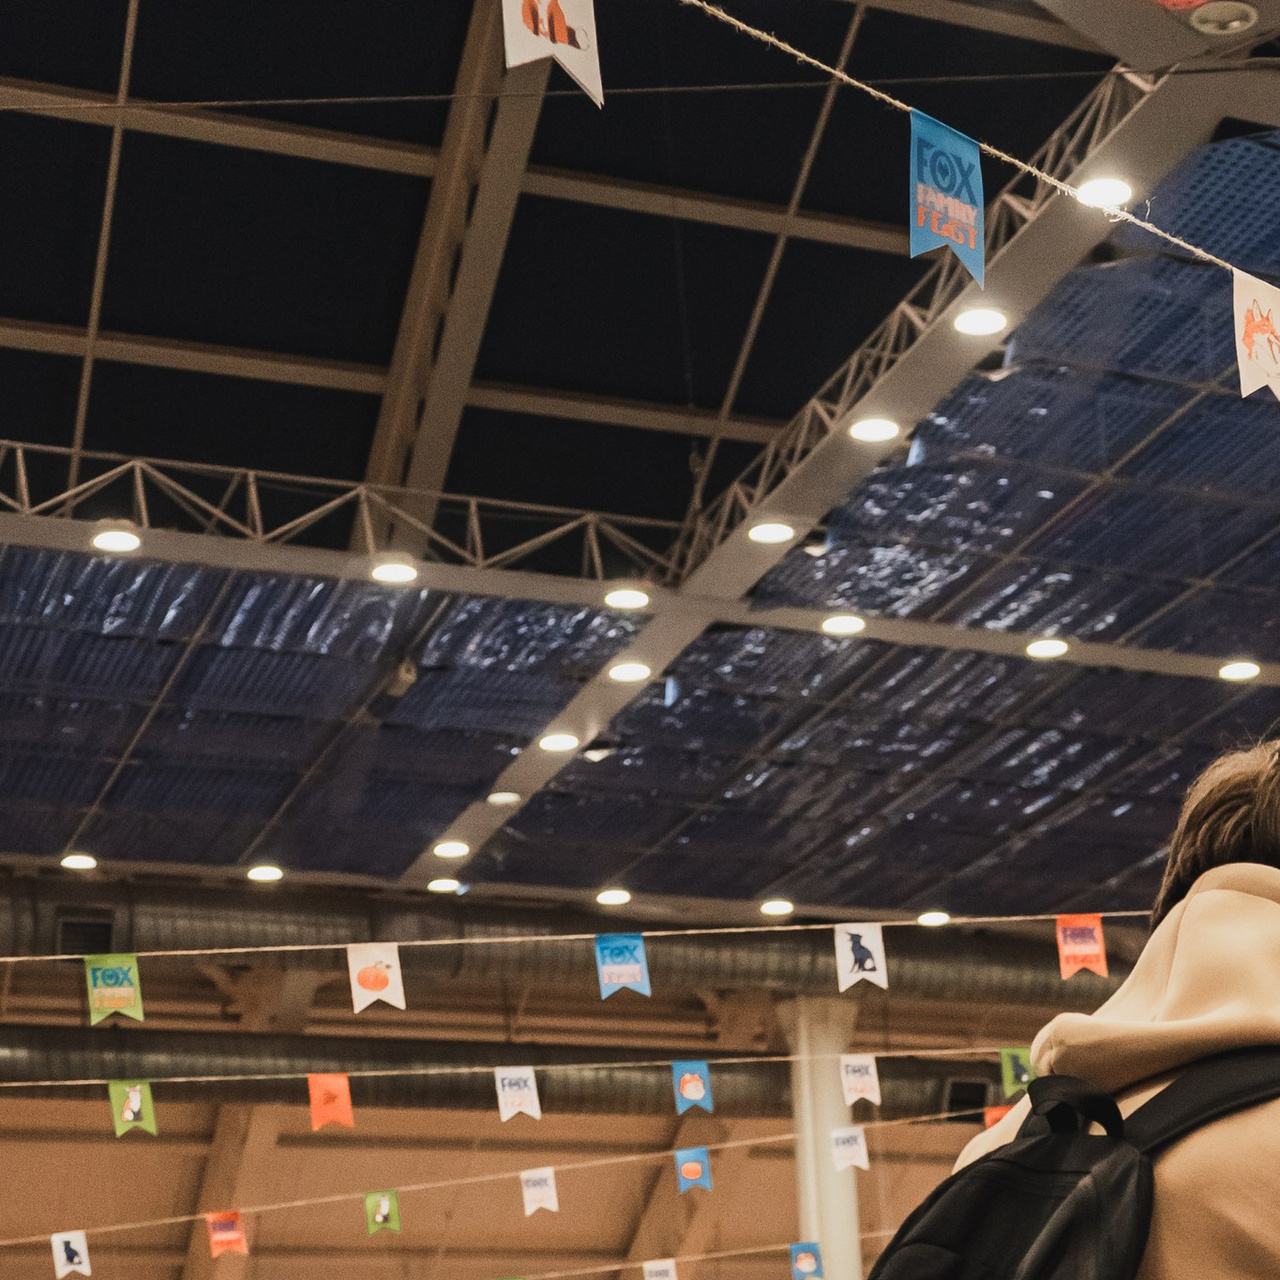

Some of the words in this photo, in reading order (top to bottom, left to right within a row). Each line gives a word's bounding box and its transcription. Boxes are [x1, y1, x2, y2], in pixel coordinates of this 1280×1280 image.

[916, 136, 978, 206] FOX
[917, 205, 979, 250] FEST
[599, 945, 640, 966] FOX
[91, 966, 134, 989] FOX
